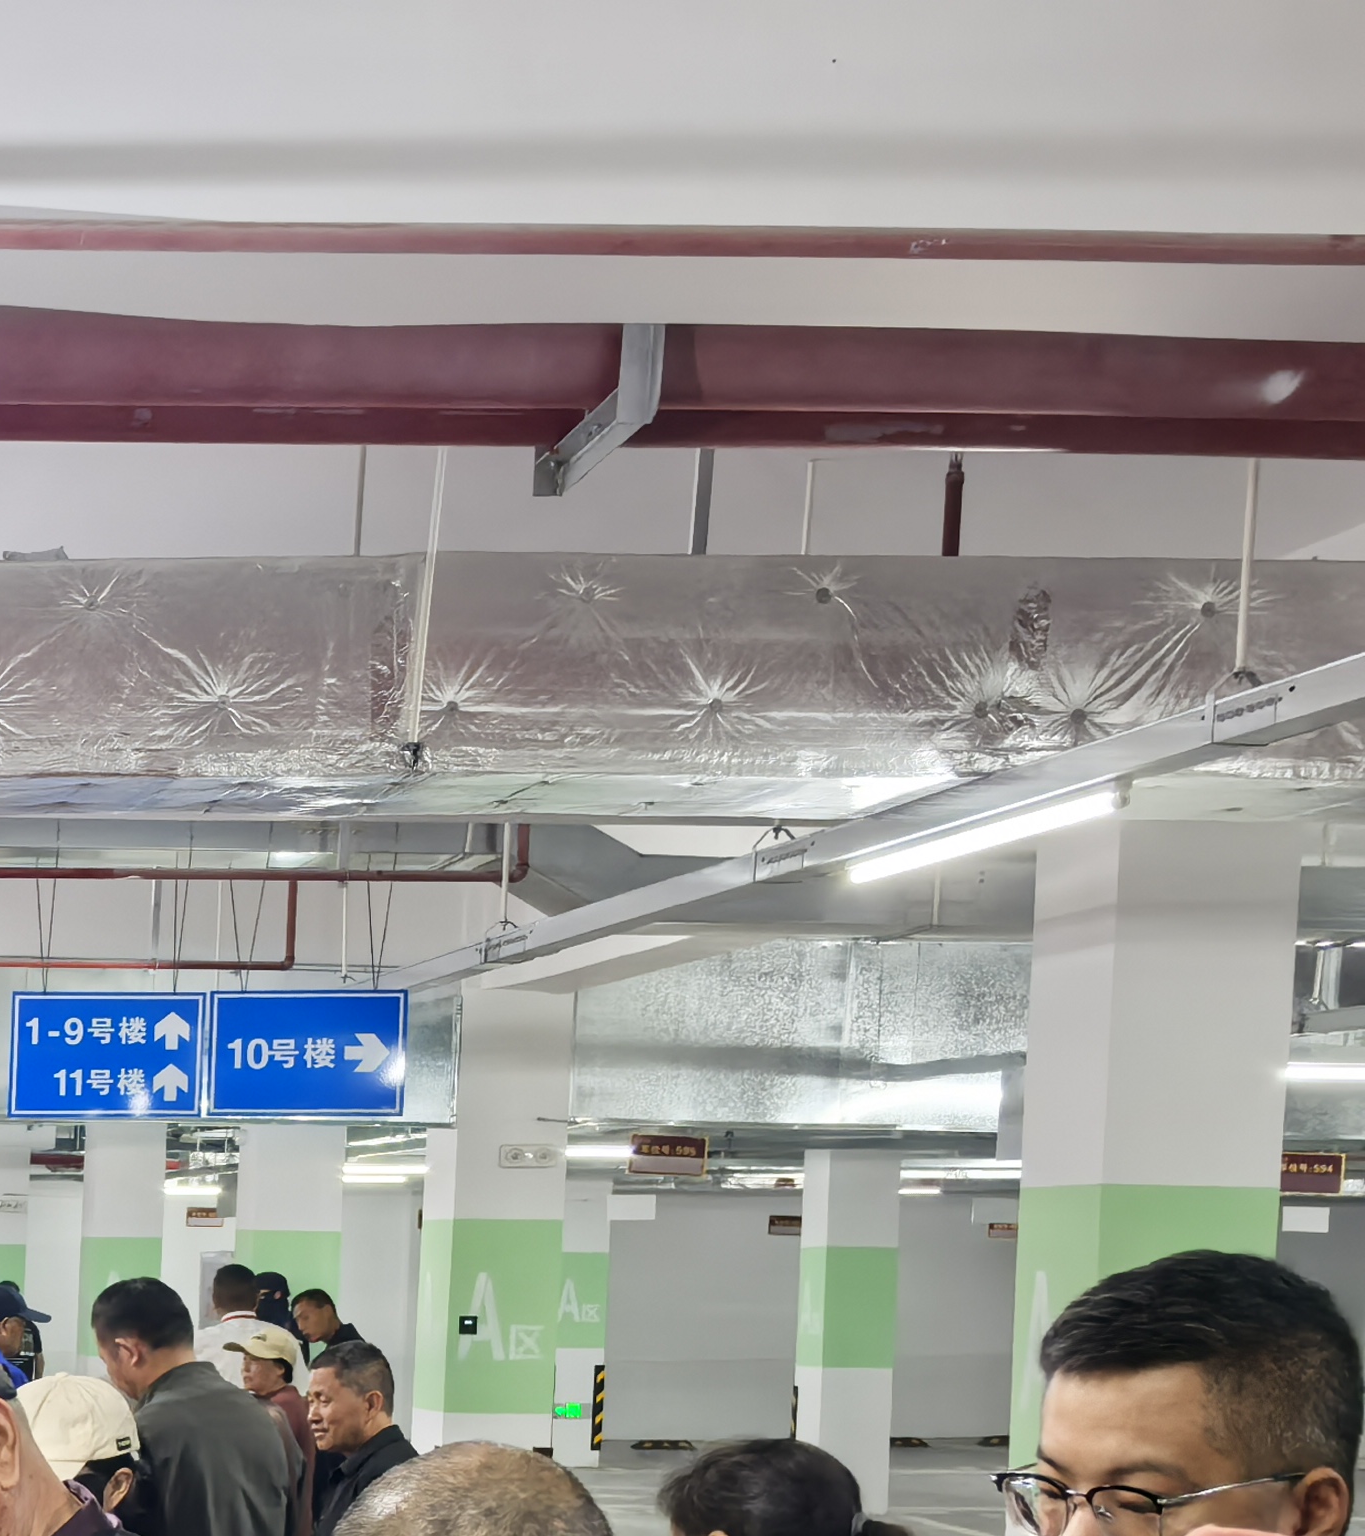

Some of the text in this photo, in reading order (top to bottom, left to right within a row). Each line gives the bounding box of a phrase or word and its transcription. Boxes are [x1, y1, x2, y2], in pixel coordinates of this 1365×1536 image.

[25, 1016, 148, 1045] 1-9号楼
[227, 1037, 336, 1070] 10号楼
[53, 1068, 146, 1097] 11号楼
[456, 1271, 545, 1362] A区
[557, 1278, 601, 1323] A区
